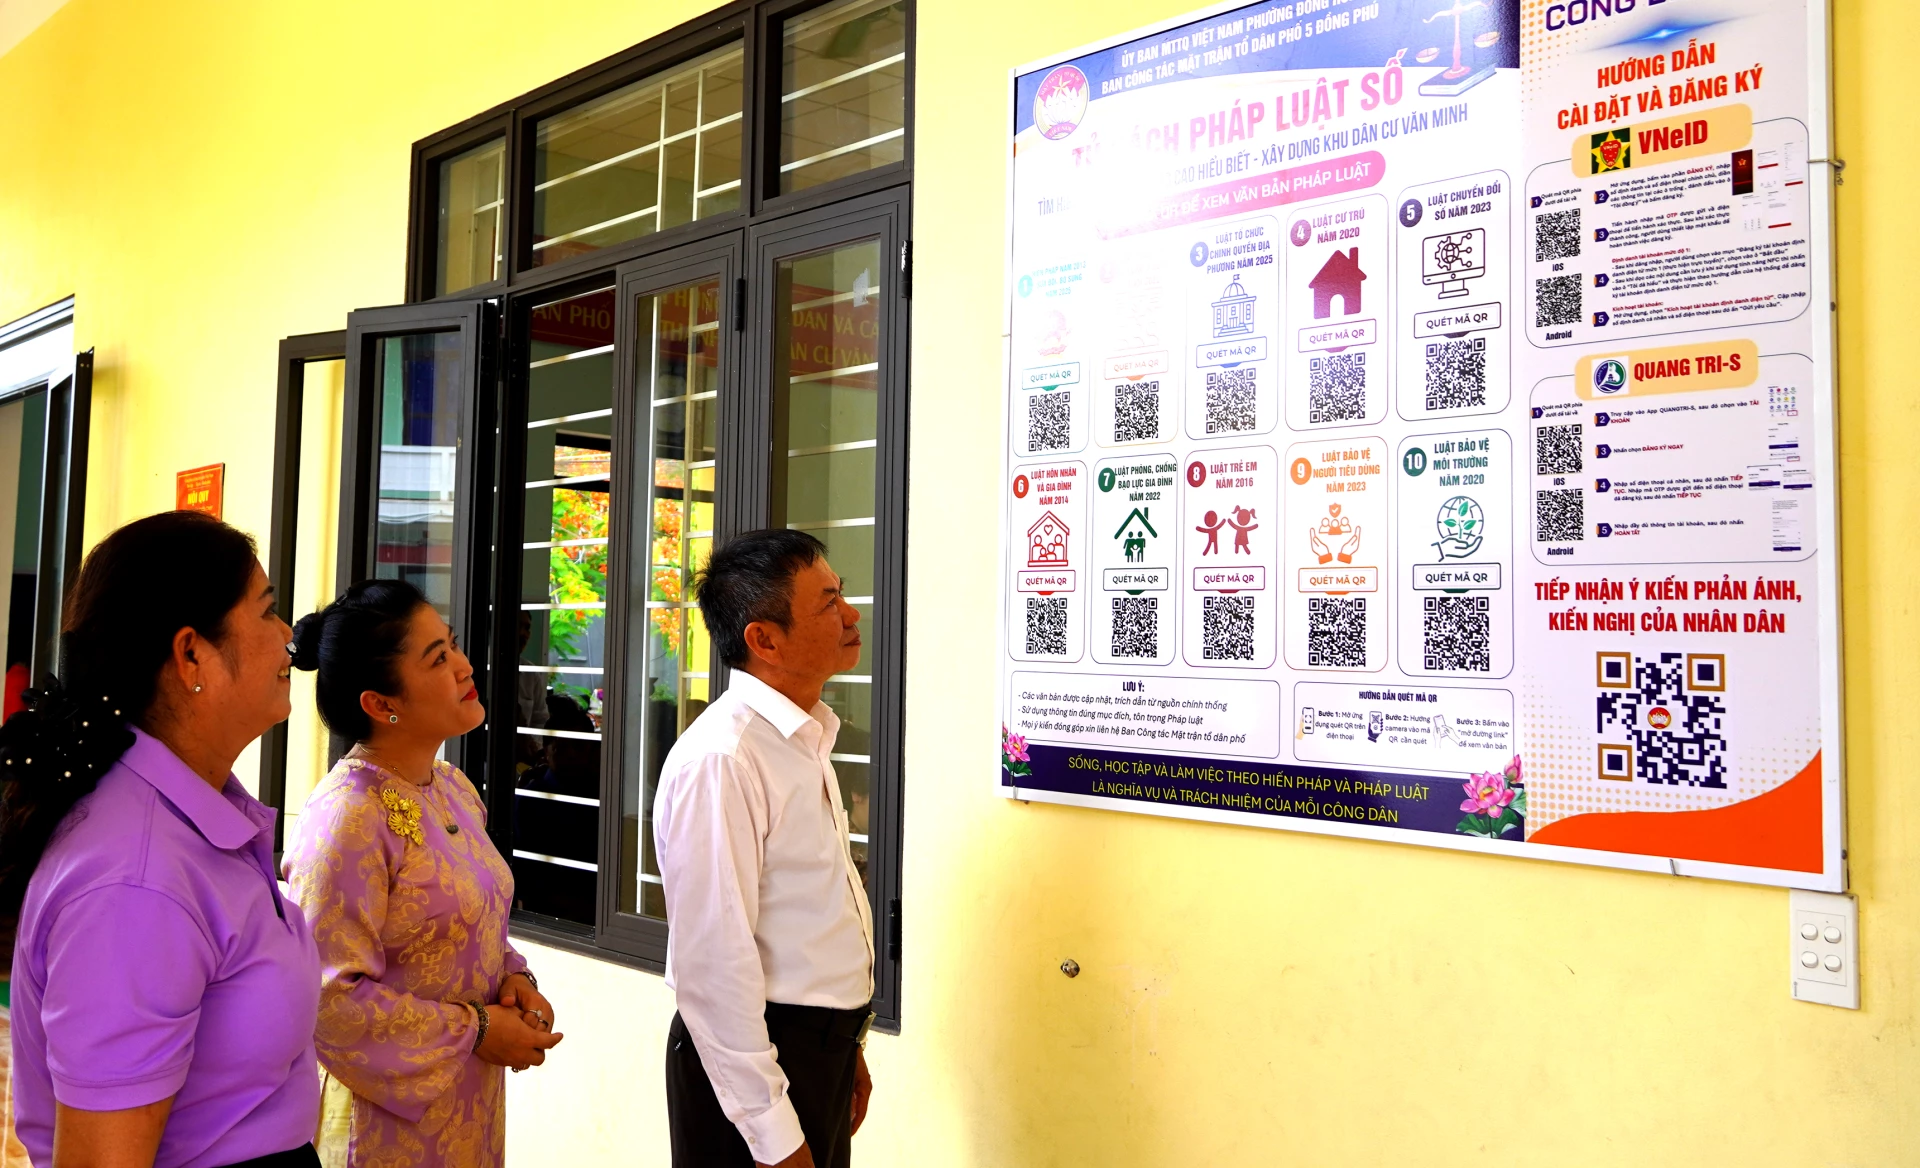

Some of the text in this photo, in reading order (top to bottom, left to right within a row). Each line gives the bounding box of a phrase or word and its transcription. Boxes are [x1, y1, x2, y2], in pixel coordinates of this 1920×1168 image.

[1121, 4, 1293, 67] ỦY BAN MTTQ VIỆT NAM PHƯỜNG
[1101, 76, 1122, 94] BAN
[1124, 68, 1152, 88] CÔNG
[1155, 61, 1175, 79] TÁC
[1177, 53, 1200, 73] MẶT
[1203, 44, 1232, 66] TRẬN
[1235, 40, 1248, 57] TỔ
[1251, 32, 1275, 53] DÂN
[1278, 25, 1301, 45] PHỐ
[1304, 21, 1312, 37] 5
[1315, 11, 1349, 34] ĐỒNG
[1352, 2, 1379, 24] PHÚ
[1597, 37, 1715, 88] HƯỚNG DẪN
[1189, 48, 1408, 152] PHÁP LUẬT SỐ
[1557, 62, 1763, 129] CÀI ĐẶT VÀ ĐĂNG KÝ
[1198, 102, 1467, 180] HIỂU BIẾT XÂY DỰNG KHU DÂN CƯ VĂN MINH
[1638, 119, 1707, 154] VNeID
[1202, 192, 1229, 210] XEM
[1232, 185, 1258, 203] VĂN
[1261, 177, 1289, 197] BẢN
[1293, 169, 1331, 191] PHÁP
[1335, 160, 1372, 183] LUẬT
[1427, 181, 1501, 206] LUẬT CHUYỂN ĐỔI
[1312, 208, 1364, 228] LUẬT CƯ TRÚ
[1405, 204, 1416, 221] 5
[1434, 200, 1491, 220] SỐ NĂM 2023
[1296, 225, 1306, 240] 4
[1317, 226, 1360, 243] NĂM 2020
[1552, 262, 1564, 271] iOS
[1426, 312, 1487, 329] QUÉT MÃ QR
[1545, 329, 1572, 340] Android
[1633, 353, 1741, 381] QUANG TRI-S
[1434, 437, 1489, 455] LUẬT BẢO VỆ
[1321, 447, 1370, 463] LUẬT BẢO VỆ
[1406, 452, 1423, 470] 10
[1433, 455, 1488, 470] MÔI TRƯỜNG
[1114, 462, 1176, 477] LUẬT PHÒNG, CHỐNG
[1192, 465, 1201, 482] 8
[1210, 459, 1257, 474] LUẬT TRẺ EM
[1297, 462, 1306, 479] 9
[1312, 464, 1380, 478] NGƯỜI TIÊU DÙNG
[1103, 472, 1110, 487] 7
[1117, 476, 1172, 490] BẠO LỰC GIA ĐÌNH
[1215, 476, 1253, 488] NĂM 2016
[1326, 480, 1366, 492] NĂM 2023
[1439, 473, 1484, 486] NĂM 2020
[1553, 477, 1565, 485] iOS
[1129, 491, 1160, 501] NĂM 2022
[1546, 546, 1573, 555] Android
[1424, 571, 1487, 583] QUÉT MÃ QR
[1534, 574, 1801, 604] TIẾP NHẬN Ý KIẾN PHẢN ÁNH,
[1548, 605, 1785, 635] KIẾN NGHỊ CỦA NHÂN DÂN
[1122, 679, 1144, 692] LƯU Ý:
[1067, 753, 1429, 801] SỐNG, HỌC TẬP VÀ LÀM VIỆC THEO HIẾN PHÁP VÀ PHÁP LUẬT
[1092, 778, 1398, 823] LÀ NGHĨA VỤ VÀ TRÁCH NHIỆM CỦA MỖI CÔNG DÂN
